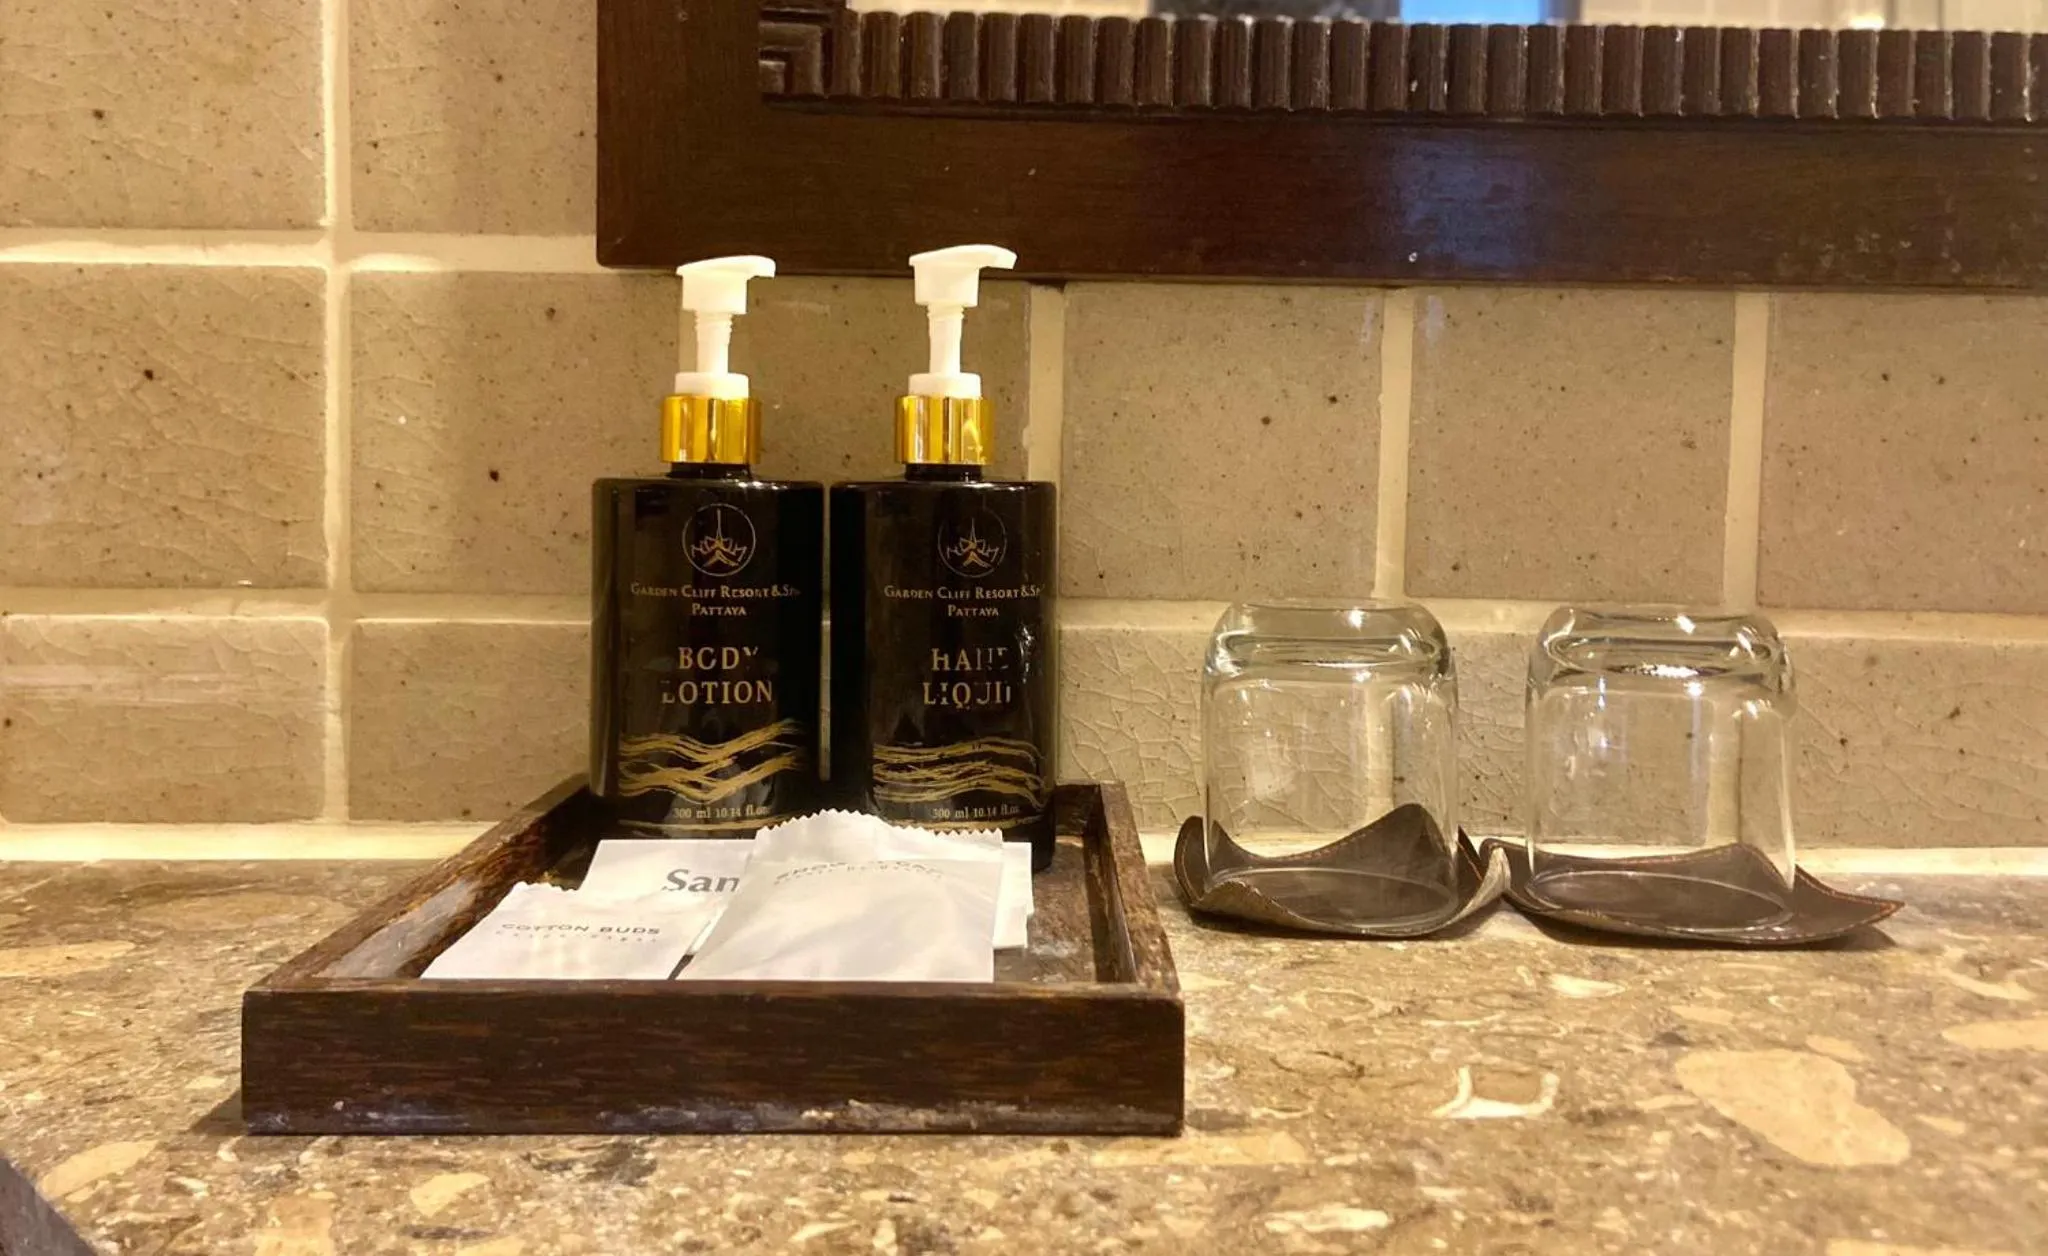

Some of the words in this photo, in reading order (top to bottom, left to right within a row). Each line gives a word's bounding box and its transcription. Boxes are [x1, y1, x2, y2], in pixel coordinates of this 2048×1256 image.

[660, 680, 772, 704] LOTION
[673, 807, 692, 819] 300
[696, 806, 711, 819] ml
[932, 808, 950, 819] 300
[955, 806, 969, 819] ml
[502, 923, 590, 932] COTTON
[599, 926, 661, 935] BUDS
